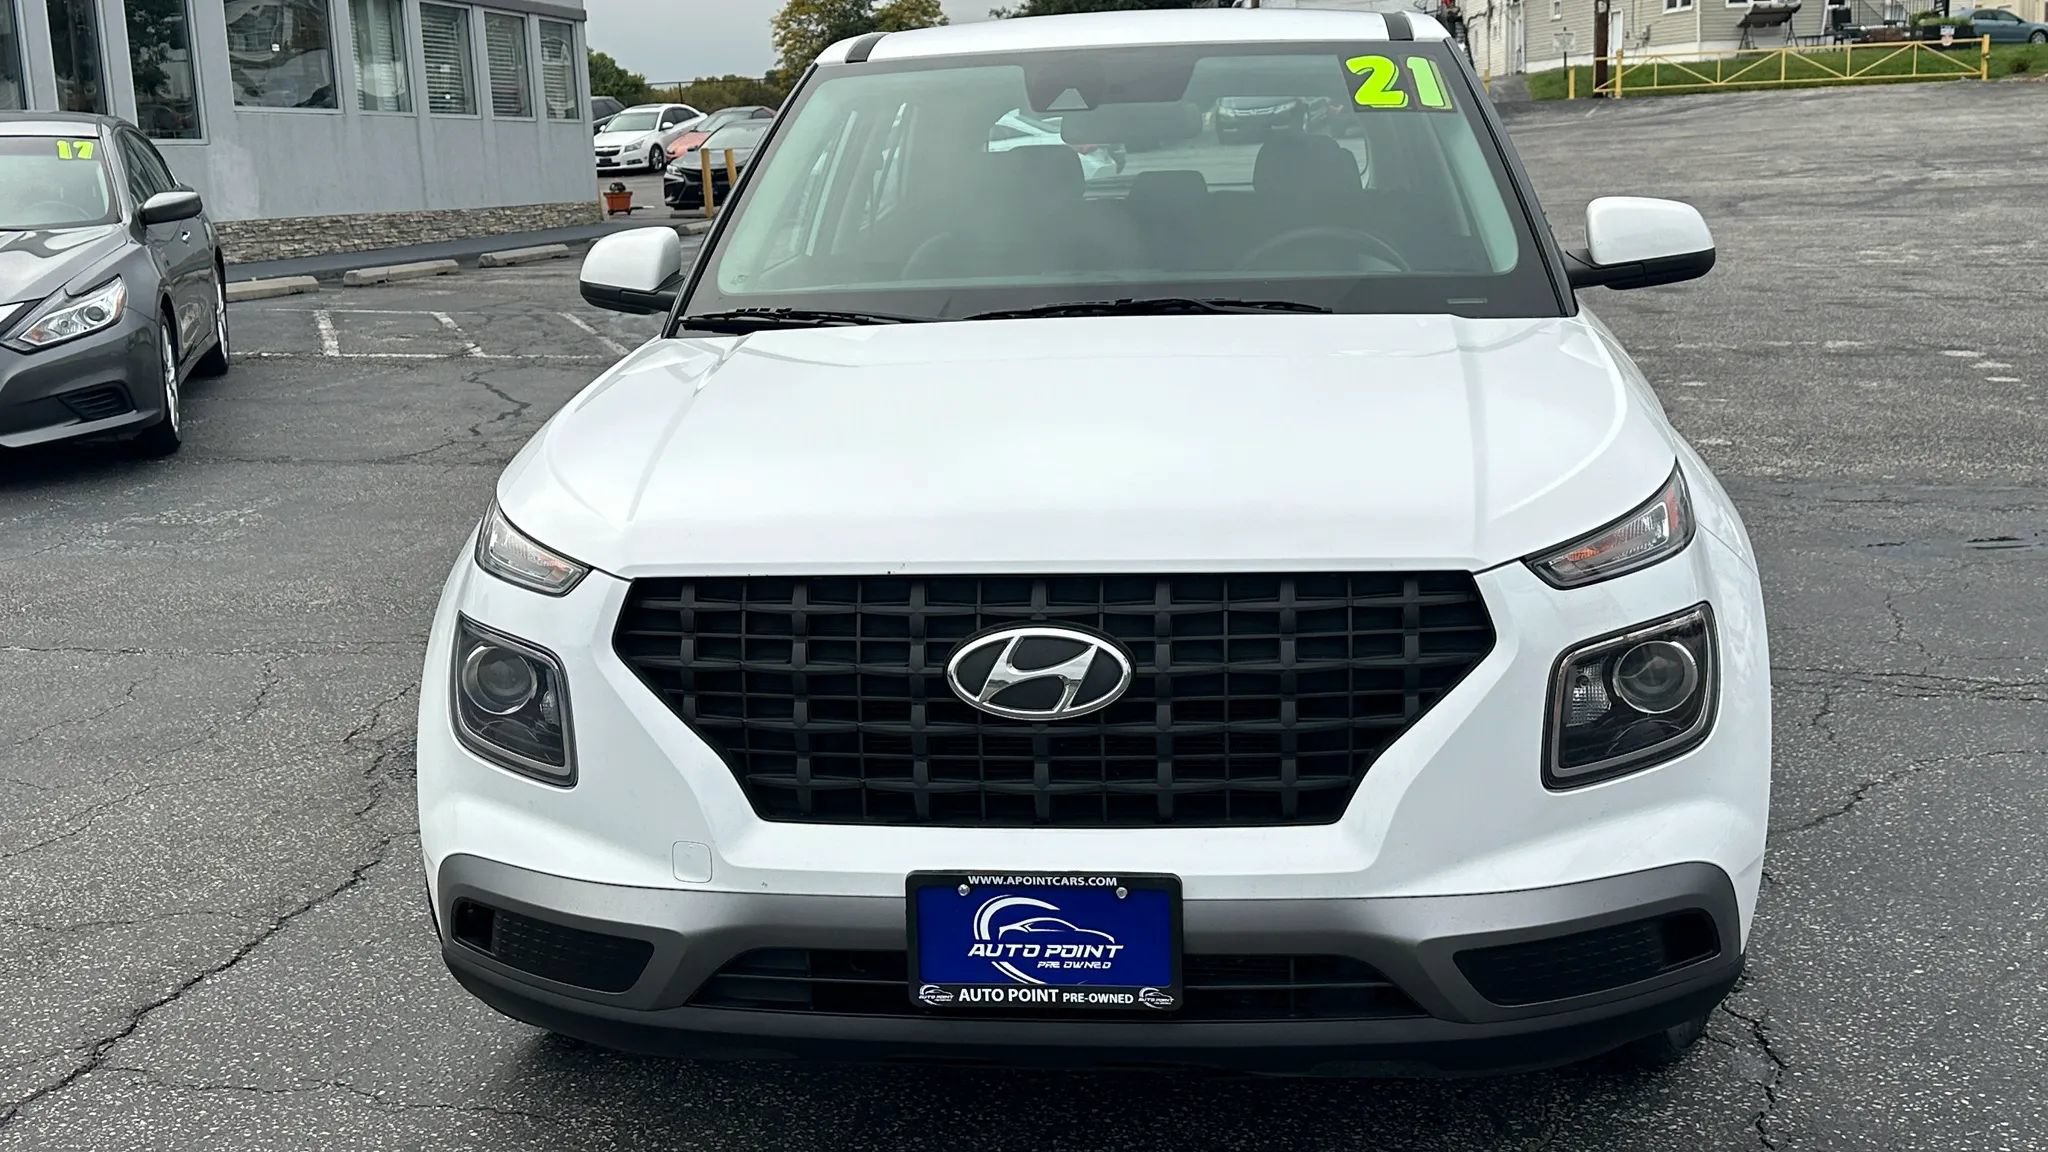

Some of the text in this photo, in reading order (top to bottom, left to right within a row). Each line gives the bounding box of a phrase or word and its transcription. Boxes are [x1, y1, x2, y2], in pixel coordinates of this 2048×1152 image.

[1345, 54, 1453, 110] 21
[56, 140, 94, 160] 17
[968, 875, 1118, 887] WWW.APOINTCARS.COM
[967, 943, 1124, 959] AUTO POINT
[1036, 961, 1112, 969] PRE OWNED
[958, 988, 1134, 1004] AUTO POINT PRE-OWNED
